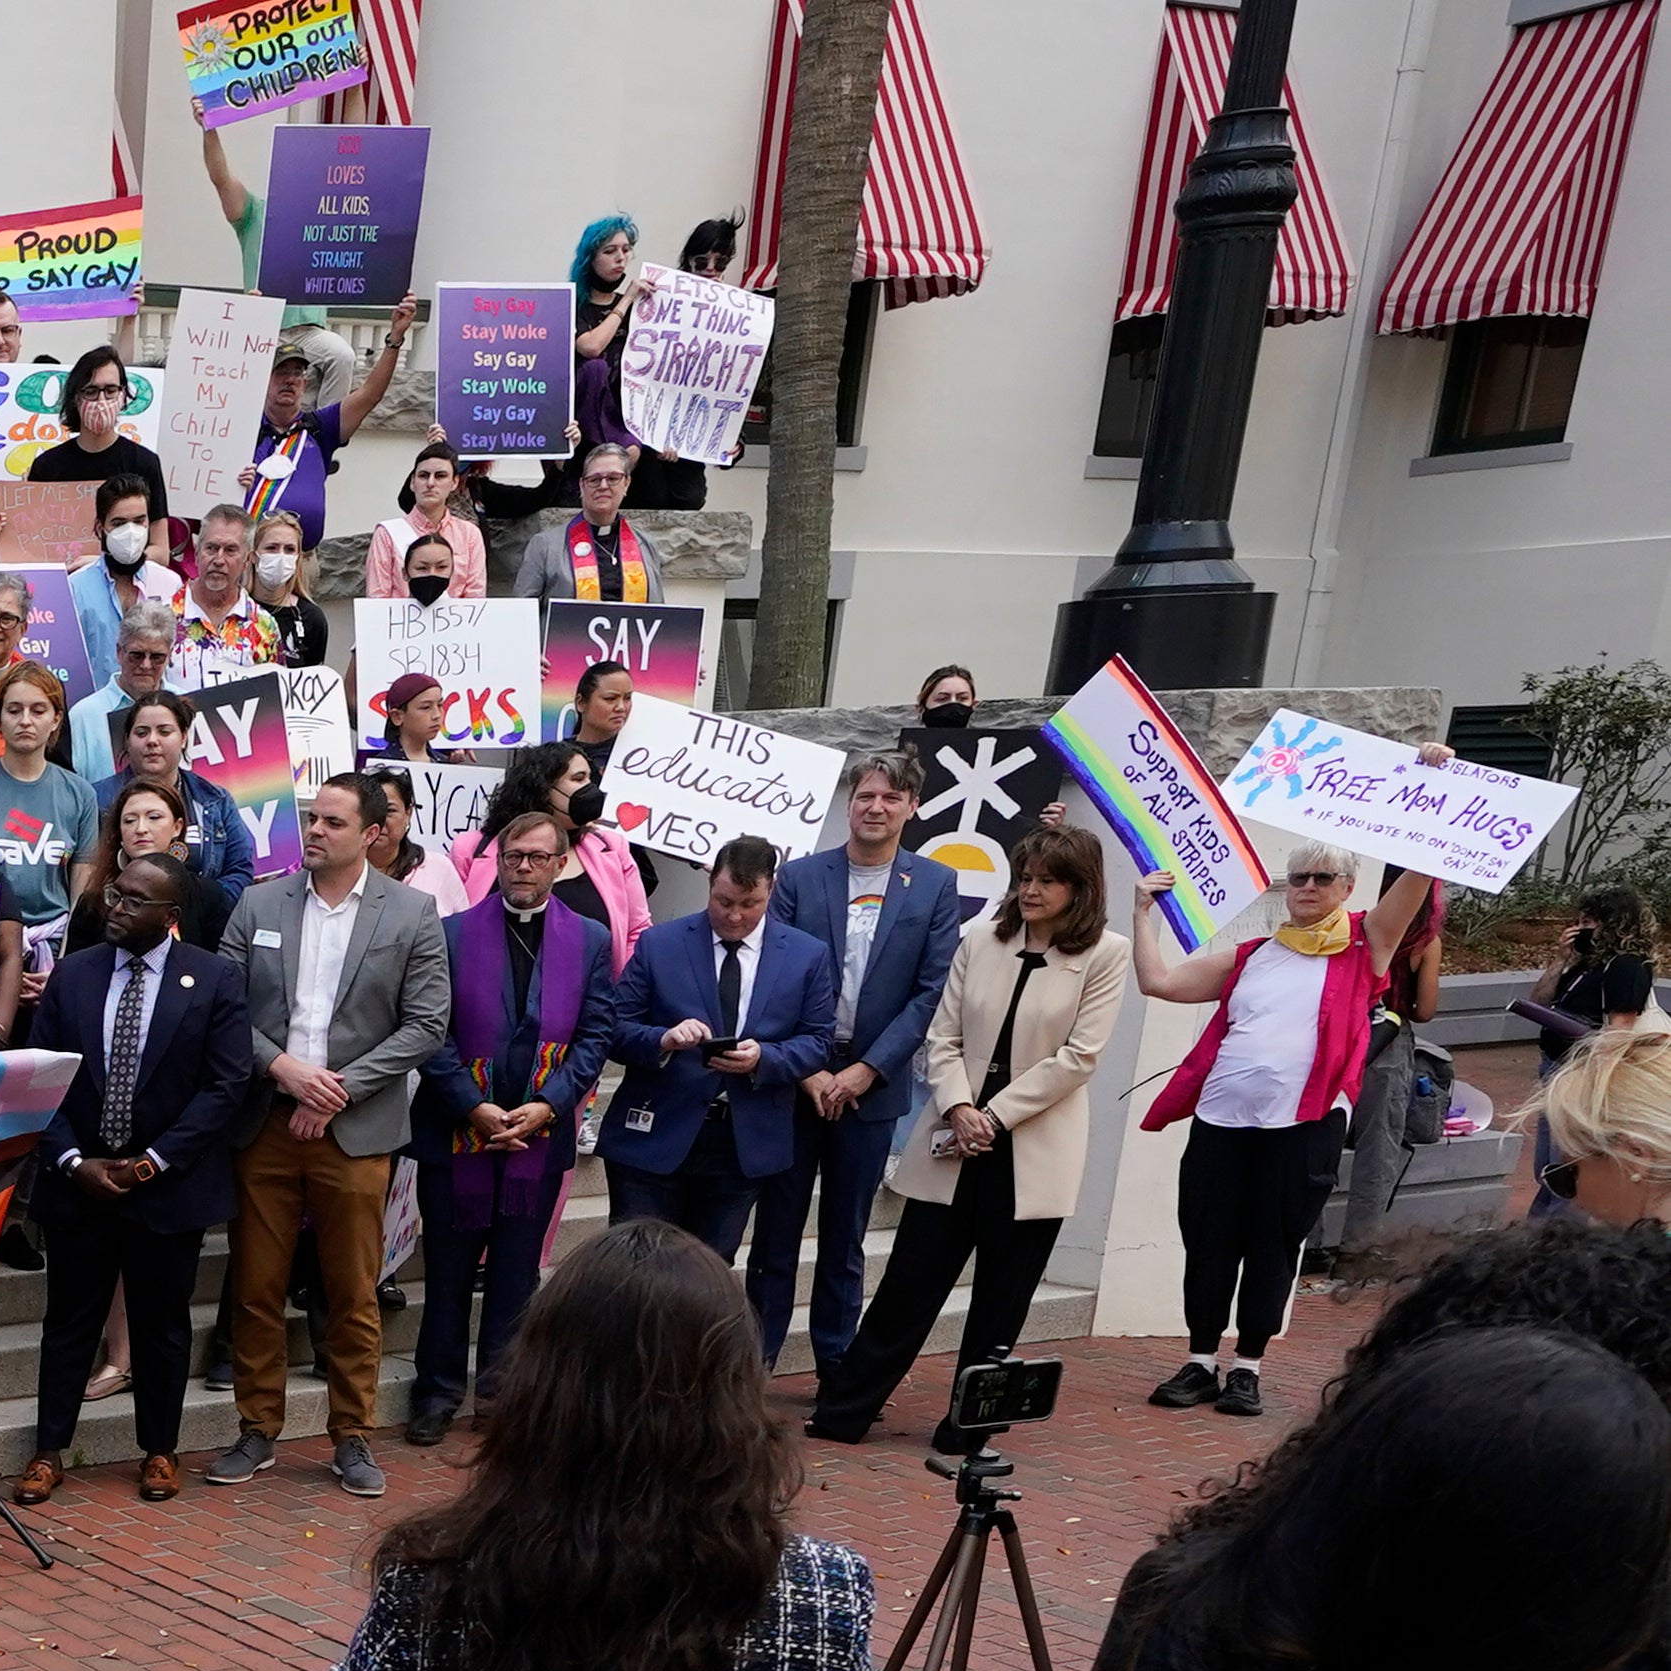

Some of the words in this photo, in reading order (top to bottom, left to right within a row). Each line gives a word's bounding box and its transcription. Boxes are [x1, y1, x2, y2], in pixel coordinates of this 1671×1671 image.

[233, 32, 299, 70] OUR
[307, 15, 348, 46] OUT
[225, 41, 360, 109] CHILDREN
[337, 134, 364, 154] GOD
[326, 165, 366, 185] LOVES
[317, 196, 339, 215] ALL
[14, 227, 118, 263] PROUD
[303, 225, 325, 242] NOT
[327, 225, 357, 242] JUST
[358, 225, 380, 243] THE
[26, 264, 79, 292] SAY
[81, 255, 139, 292] GAY
[305, 276, 336, 294] WHITE
[337, 277, 366, 294] ONES
[473, 296, 502, 316] Say
[505, 297, 537, 317] Gay
[728, 288, 772, 315] GET
[691, 302, 752, 337] THING
[187, 326, 230, 350] Will
[243, 334, 276, 355] Not
[462, 323, 498, 344] Stay
[501, 322, 548, 341] Woke
[191, 356, 250, 380] Teach
[473, 350, 502, 371] Say
[505, 351, 538, 372] Gay
[196, 382, 229, 409] My
[462, 377, 499, 399] Stay
[501, 377, 548, 396] Woke
[170, 411, 231, 438] Child
[473, 403, 502, 425] Say
[505, 404, 537, 425] Gay
[462, 431, 499, 452] Stay
[502, 431, 547, 449] Woke
[18, 637, 51, 658] Gay
[585, 616, 663, 672] SAY
[688, 711, 775, 765] THIS
[614, 746, 824, 824] educator
[1305, 756, 1387, 804] FREE
[1448, 795, 1535, 851] HUGS
[1123, 764, 1148, 786] OF
[1142, 793, 1172, 827] ALL
[1172, 829, 1227, 908] STRIPES
[1189, 813, 1231, 864] KIDS
[1366, 820, 1403, 839] VOTE
[1405, 830, 1425, 844] NO
[1471, 866, 1501, 881] BILL
